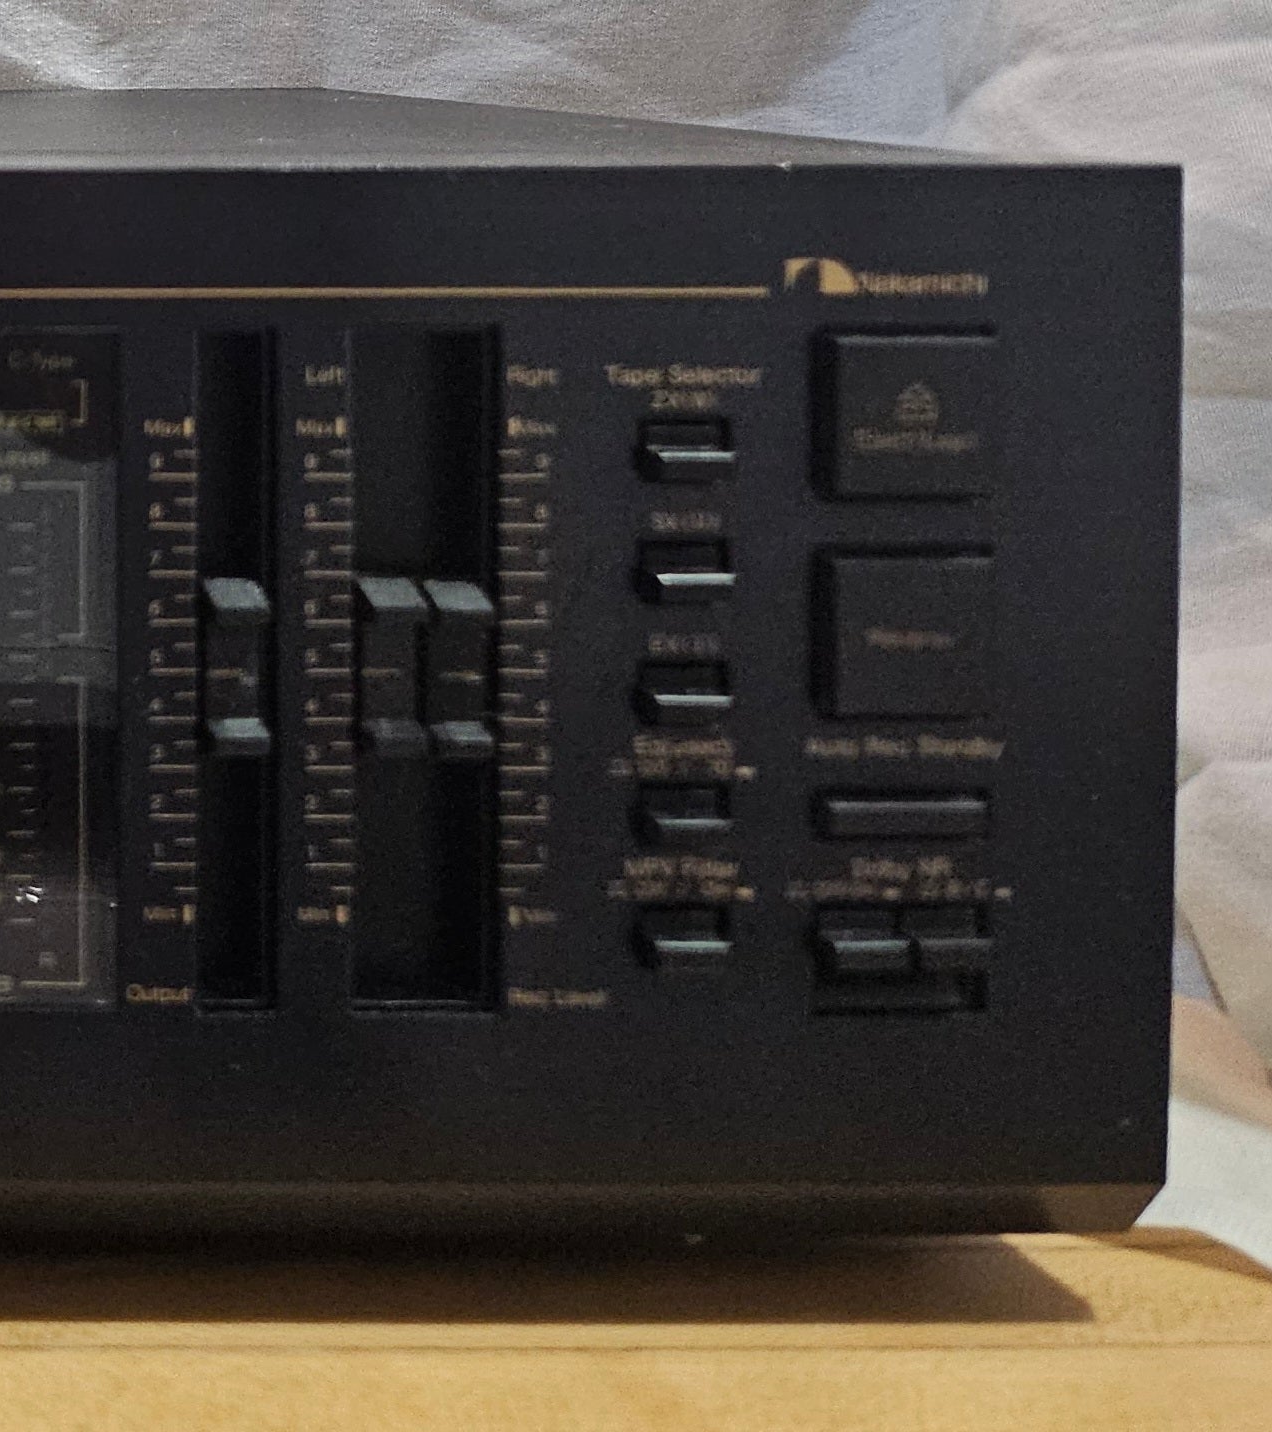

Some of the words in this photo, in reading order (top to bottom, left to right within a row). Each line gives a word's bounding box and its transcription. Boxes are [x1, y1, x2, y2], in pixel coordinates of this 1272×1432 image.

[304, 364, 346, 386] Left
[506, 364, 558, 388] Right
[604, 364, 661, 388] Tape
[665, 364, 762, 388] Selector
[143, 420, 182, 438] Max
[295, 419, 335, 438] Max
[126, 982, 194, 1005] Output
